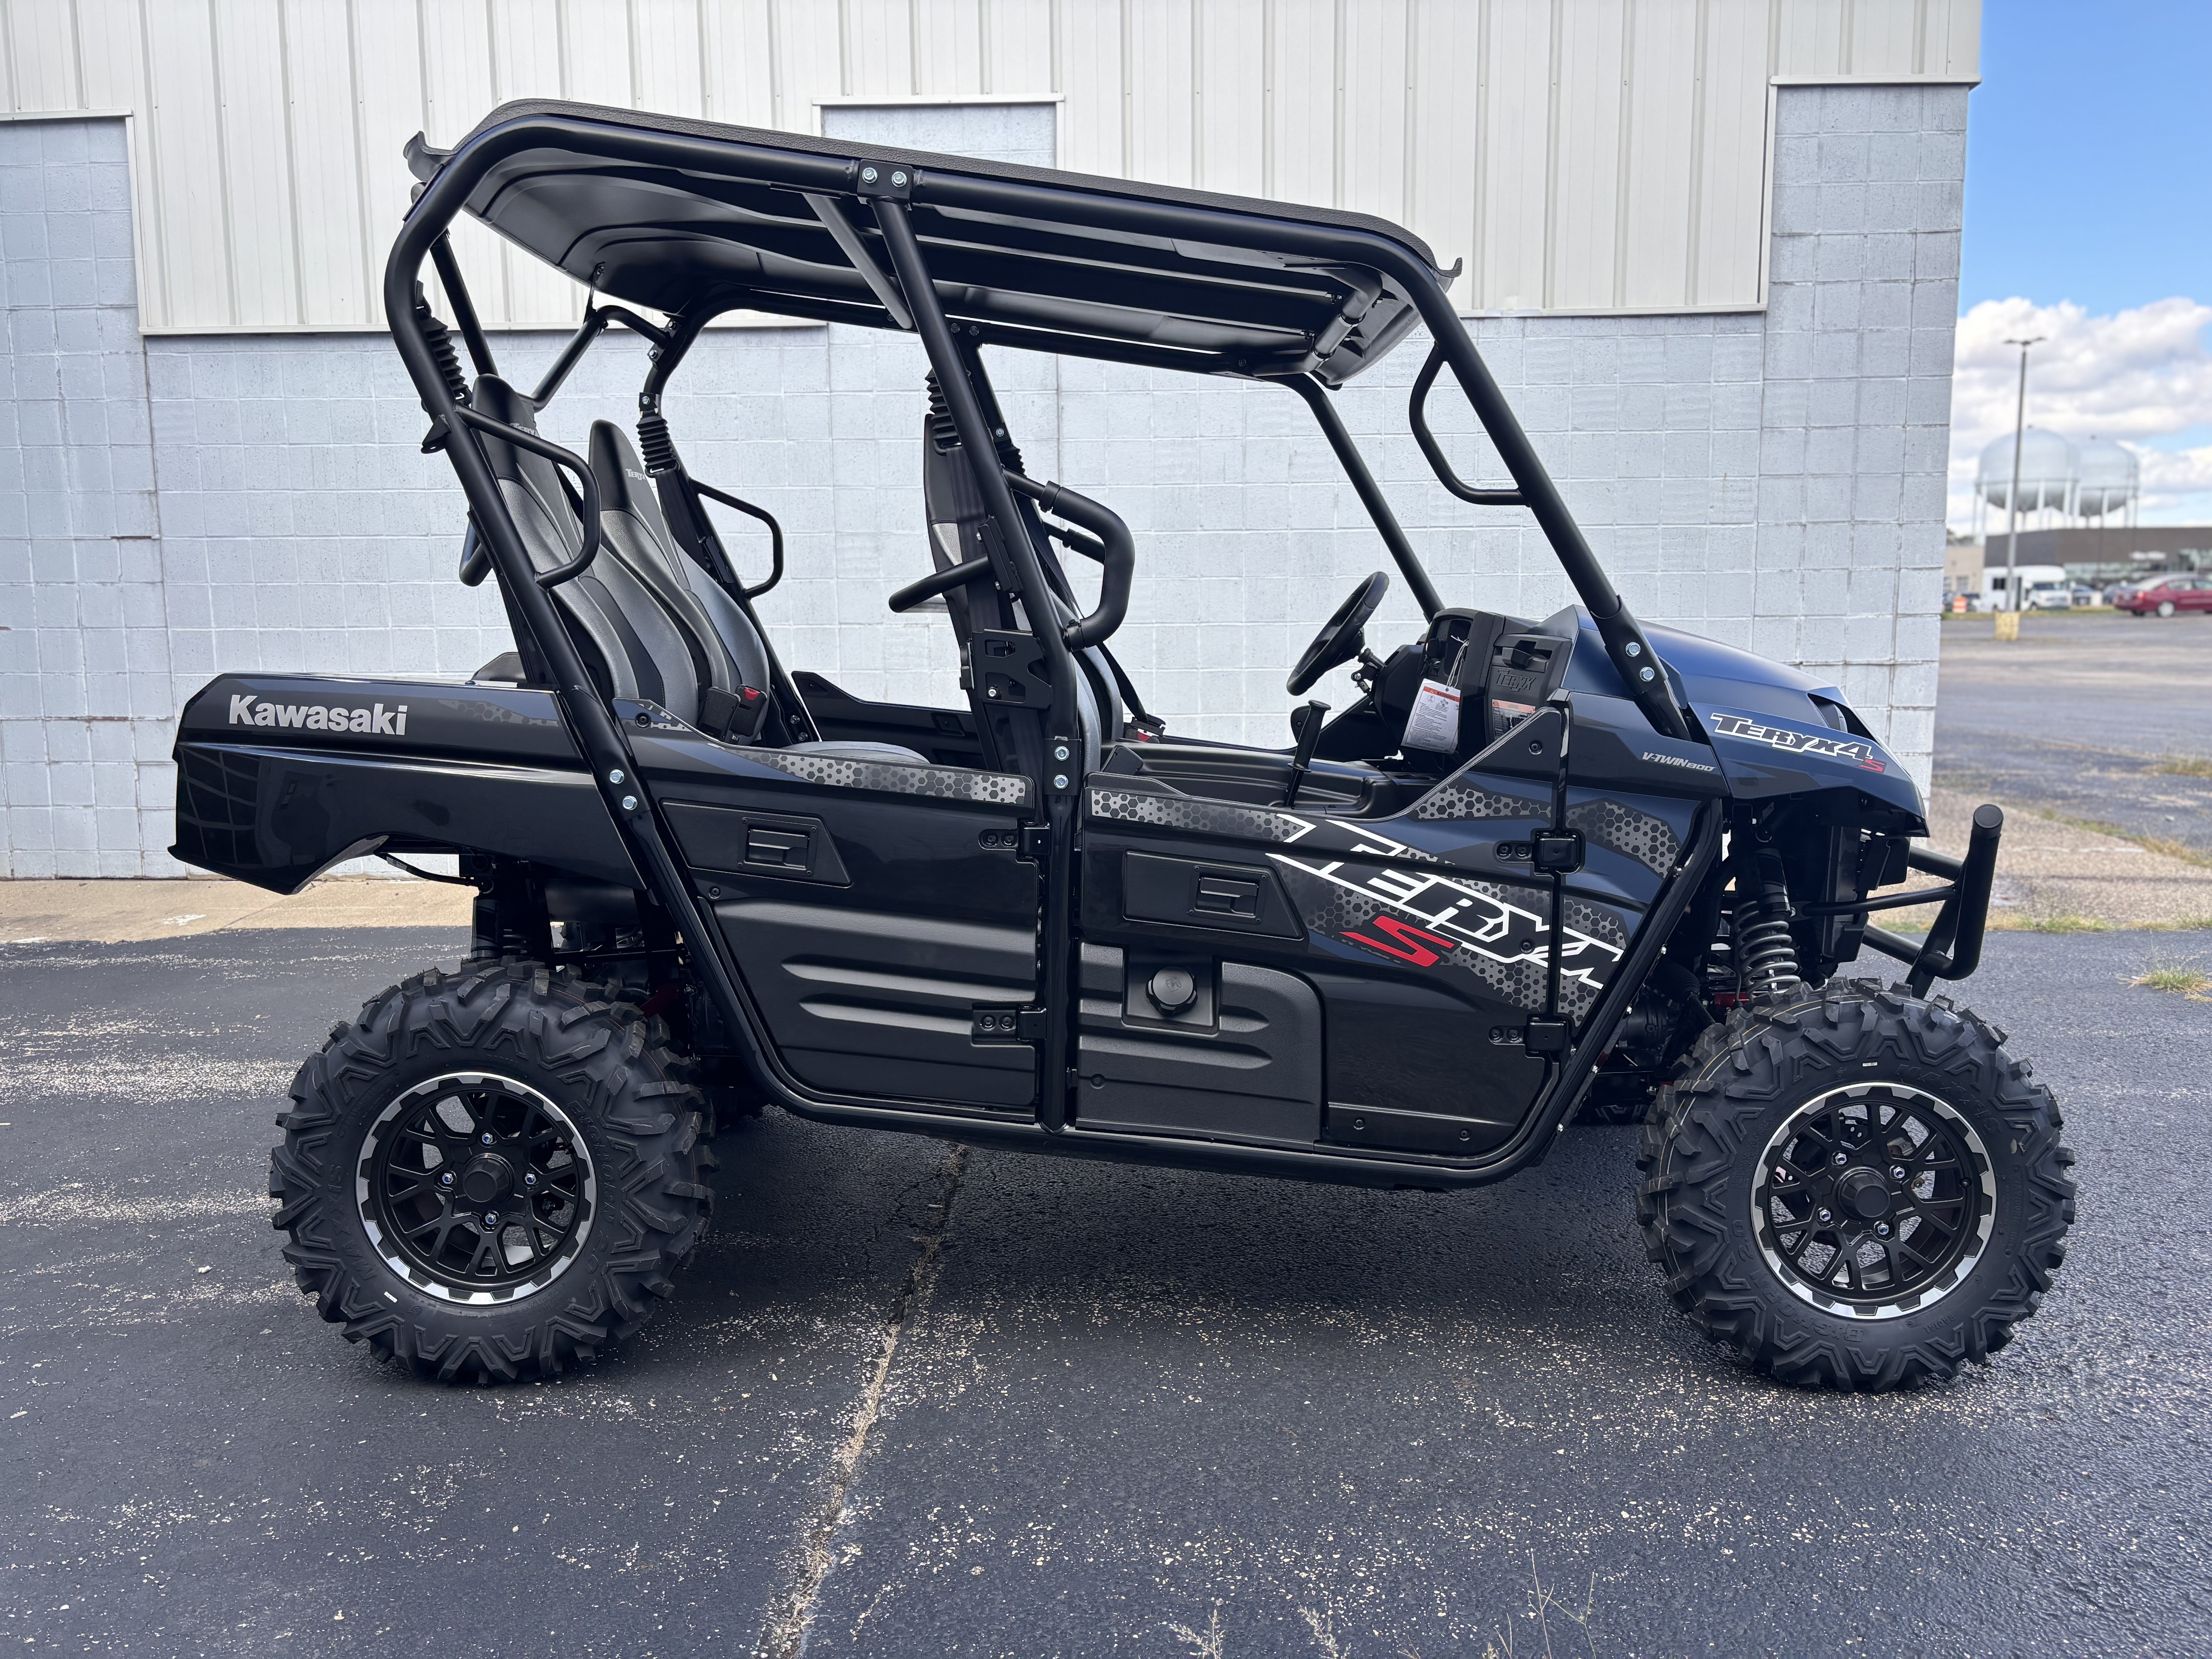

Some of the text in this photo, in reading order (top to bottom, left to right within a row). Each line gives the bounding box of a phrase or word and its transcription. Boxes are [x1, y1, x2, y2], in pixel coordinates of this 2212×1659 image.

[1437, 691, 1455, 701] WARNING
[1496, 669, 1536, 692] TERYX
[229, 695, 408, 735] Kawasaki
[1710, 713, 1873, 761] TERYX4
[1339, 915, 1455, 967] S
[1896, 1064, 2002, 1136] MAXXIS
[327, 1164, 377, 1281] MAXXIS
[1732, 1219, 1755, 1262] 2.0
[1749, 1269, 1864, 1343] BIGHORN
[1923, 1313, 1956, 1334] RADIAL
